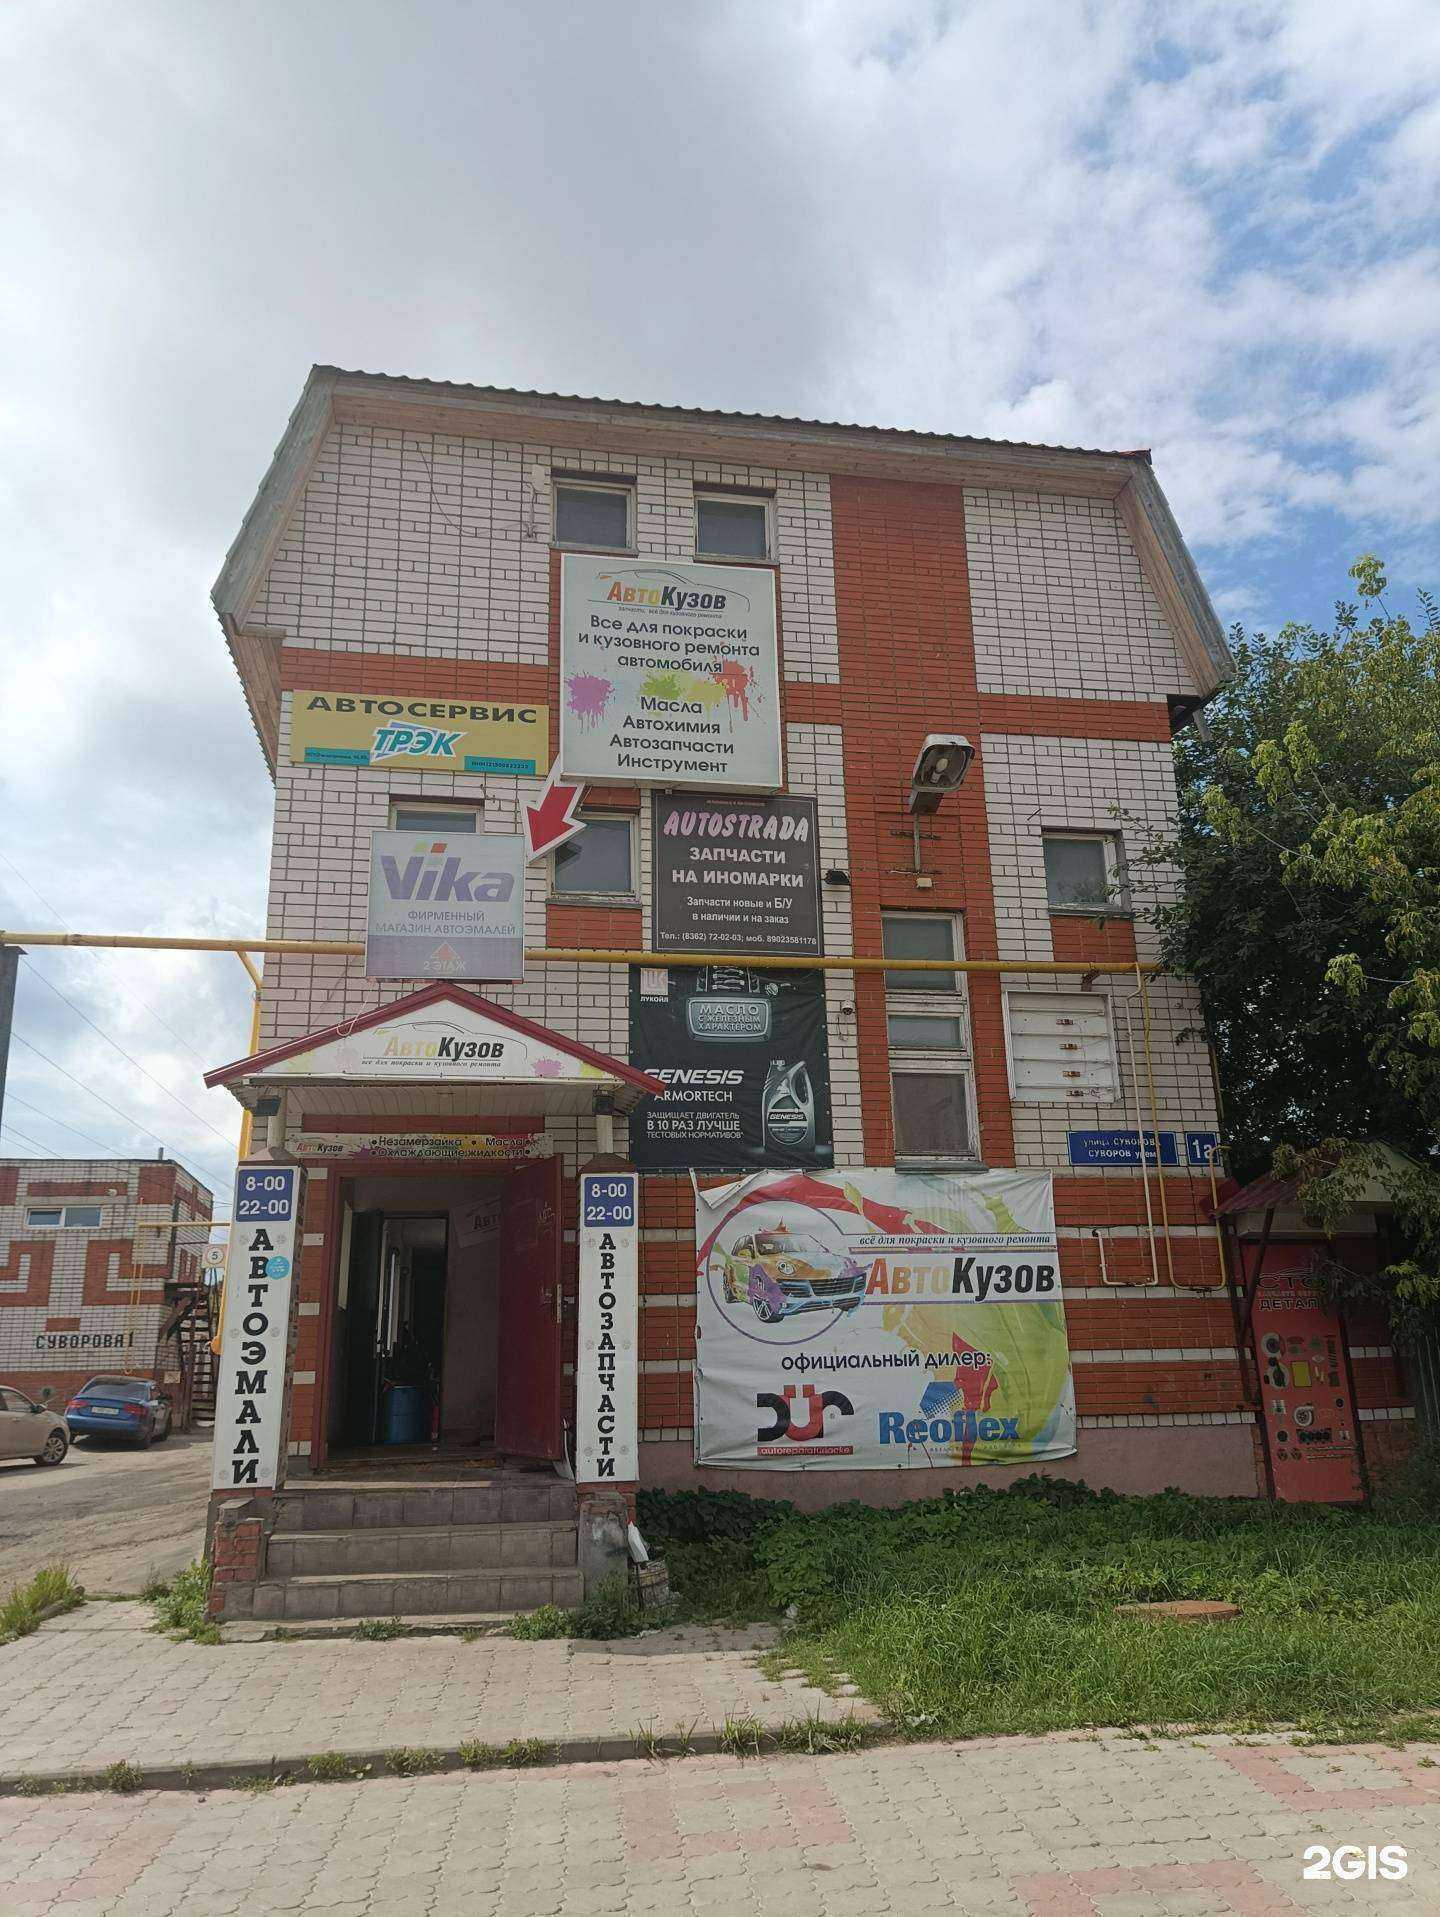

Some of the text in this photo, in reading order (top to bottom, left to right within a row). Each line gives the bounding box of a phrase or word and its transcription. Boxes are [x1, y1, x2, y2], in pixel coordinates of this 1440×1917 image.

[607, 581, 726, 610] АвтоКузов
[590, 614, 747, 639] Все для покраски
[578, 633, 760, 657] и кузовного ремонта
[618, 655, 722, 673] автомобиля
[306, 696, 537, 723] АВТОСЕРВИС
[640, 696, 702, 713] Масла
[622, 715, 721, 734] Автохимия
[373, 727, 461, 756] ТРЭК
[610, 734, 734, 754] Автозапчасти
[617, 754, 728, 772] Инструмент
[663, 811, 809, 843] AUTOSTRADA
[689, 847, 787, 864] ЗАПЧАСТИ
[380, 843, 515, 902] Vika
[672, 869, 804, 888] НА ИНОМАРКИ
[687, 896, 793, 909] Запчасти новые и Б/У
[408, 910, 485, 921] ФИРМЕННЫЙ
[692, 913, 698, 921] в
[701, 913, 741, 922] наличии
[751, 915, 763, 923] на
[764, 916, 789, 924] заказ
[376, 923, 516, 935] МАГАЗИН АВТОЭМАЛЕЙ
[700, 1004, 759, 1016] МАСЛО
[698, 1023, 762, 1031] ХАРАКТЕРОМ
[707, 1015, 762, 1023] ЖЕЛЕЗНЫМ
[383, 1036, 505, 1062] АвтоКузов
[647, 1111, 740, 1120] ЗАЩИЩАЕТ ДВИГАТЕЛЬ
[647, 1121, 740, 1131] В 10 РАЗ ЛУЧШЕ
[647, 1131, 687, 1139] ТЕСТОВЫХ
[245, 1175, 286, 1191] 8-00
[591, 1183, 627, 1198] 8-00
[238, 1200, 290, 1215] 22-00
[586, 1206, 632, 1221] 22-00
[474, 1213, 502, 1230] Авт
[859, 1236, 1050, 1247] всё для покраски и кузовного ремонта
[865, 1257, 1056, 1302] АвтоКузов
[36, 1333, 125, 1349] СУВОРОВА
[231, 1228, 274, 1485] АВТОЭМАЛИ
[596, 1233, 617, 1478] АВТОЗАПЧАСТИ
[781, 1350, 992, 1373] официальный дилер:
[878, 1409, 1020, 1444] Reoflex
